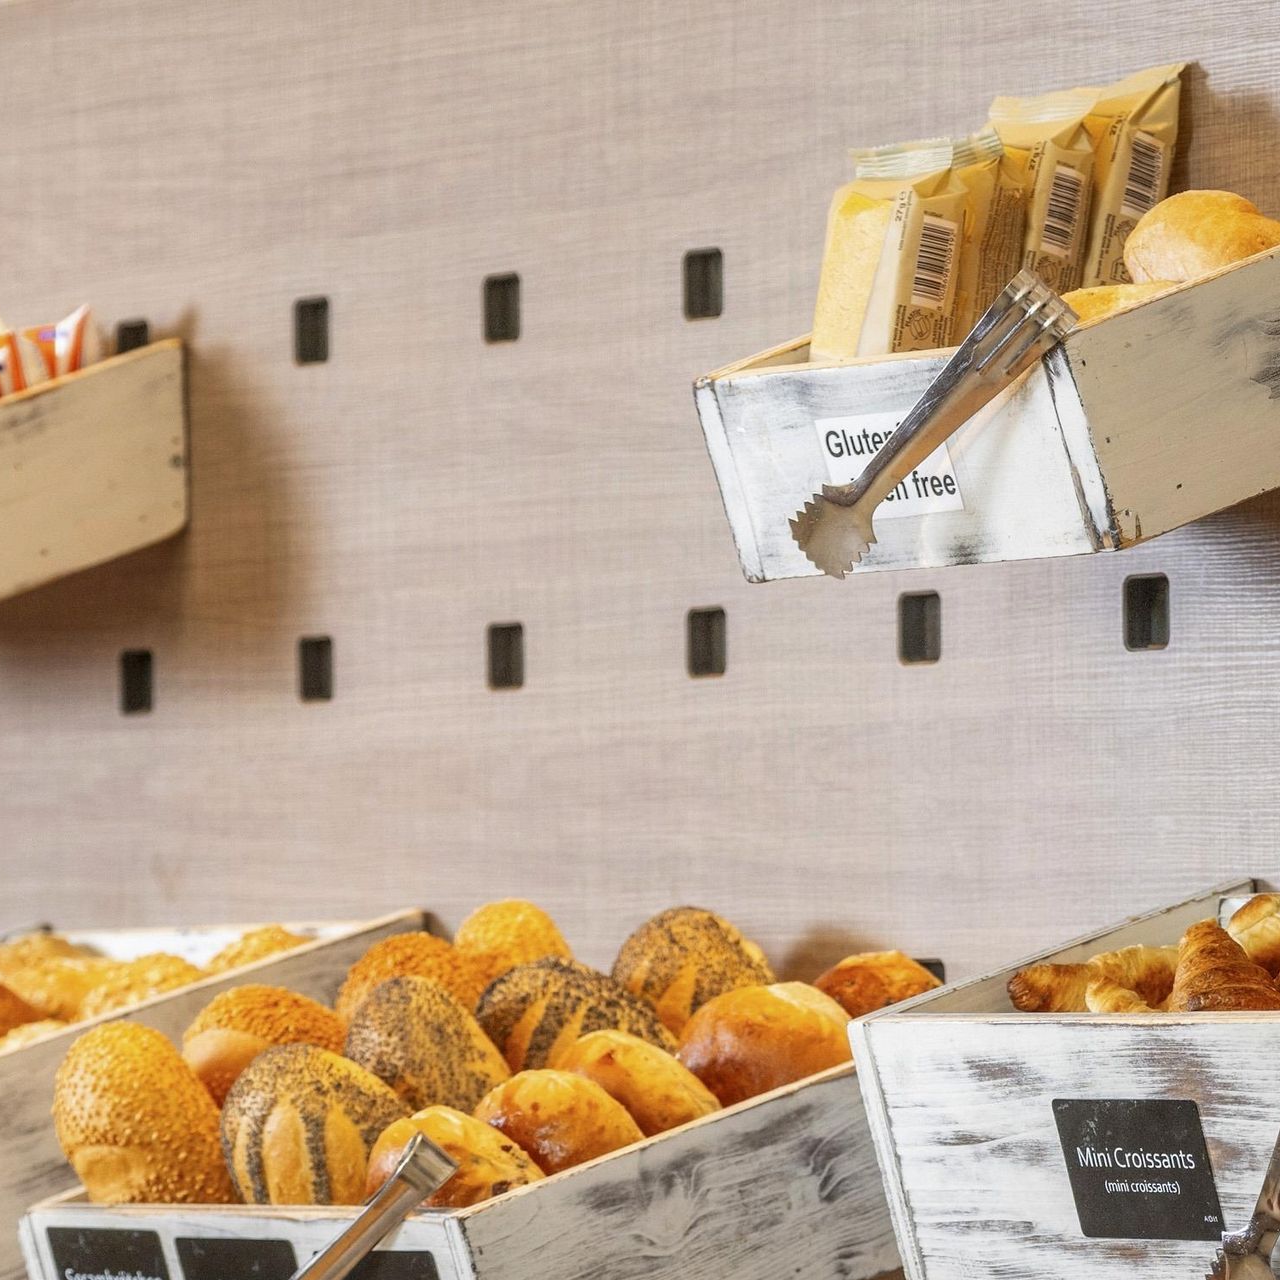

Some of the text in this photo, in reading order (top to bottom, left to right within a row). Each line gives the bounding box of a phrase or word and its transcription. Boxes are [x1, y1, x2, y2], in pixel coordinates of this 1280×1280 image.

[912, 471, 956, 498] free
[1076, 1147, 1196, 1170] Mini Croissants
[1104, 1180, 1181, 1195] (mini croissants)
